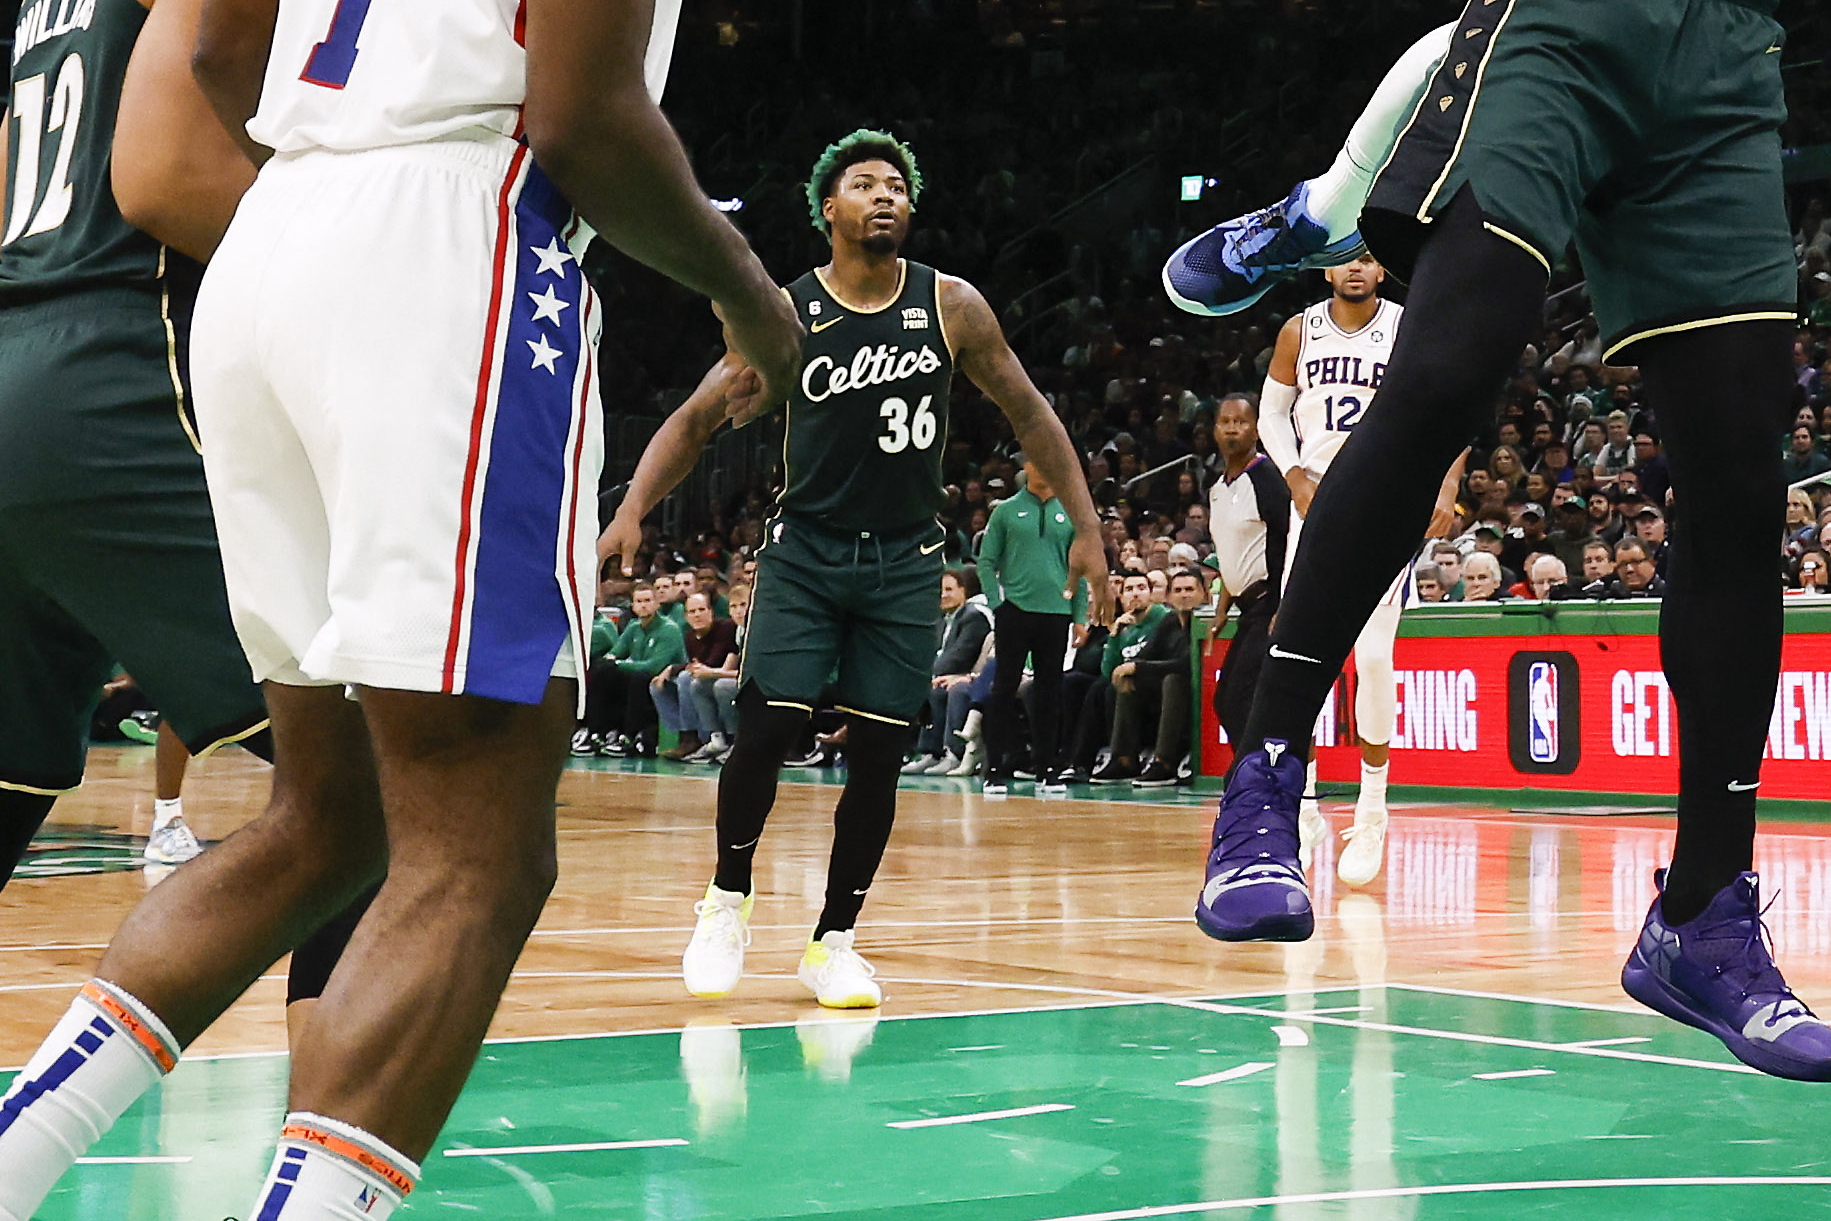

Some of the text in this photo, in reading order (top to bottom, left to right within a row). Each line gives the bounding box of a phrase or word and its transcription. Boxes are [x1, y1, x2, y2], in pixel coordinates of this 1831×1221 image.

[1, 52, 85, 247] 12
[808, 300, 822, 316] 6
[901, 307, 928, 320] VISTA
[902, 318, 929, 330] PRINT
[801, 344, 942, 403] Celtics
[878, 394, 937, 454] 36
[1325, 395, 1361, 432] 12
[1611, 669, 1671, 757] GET
